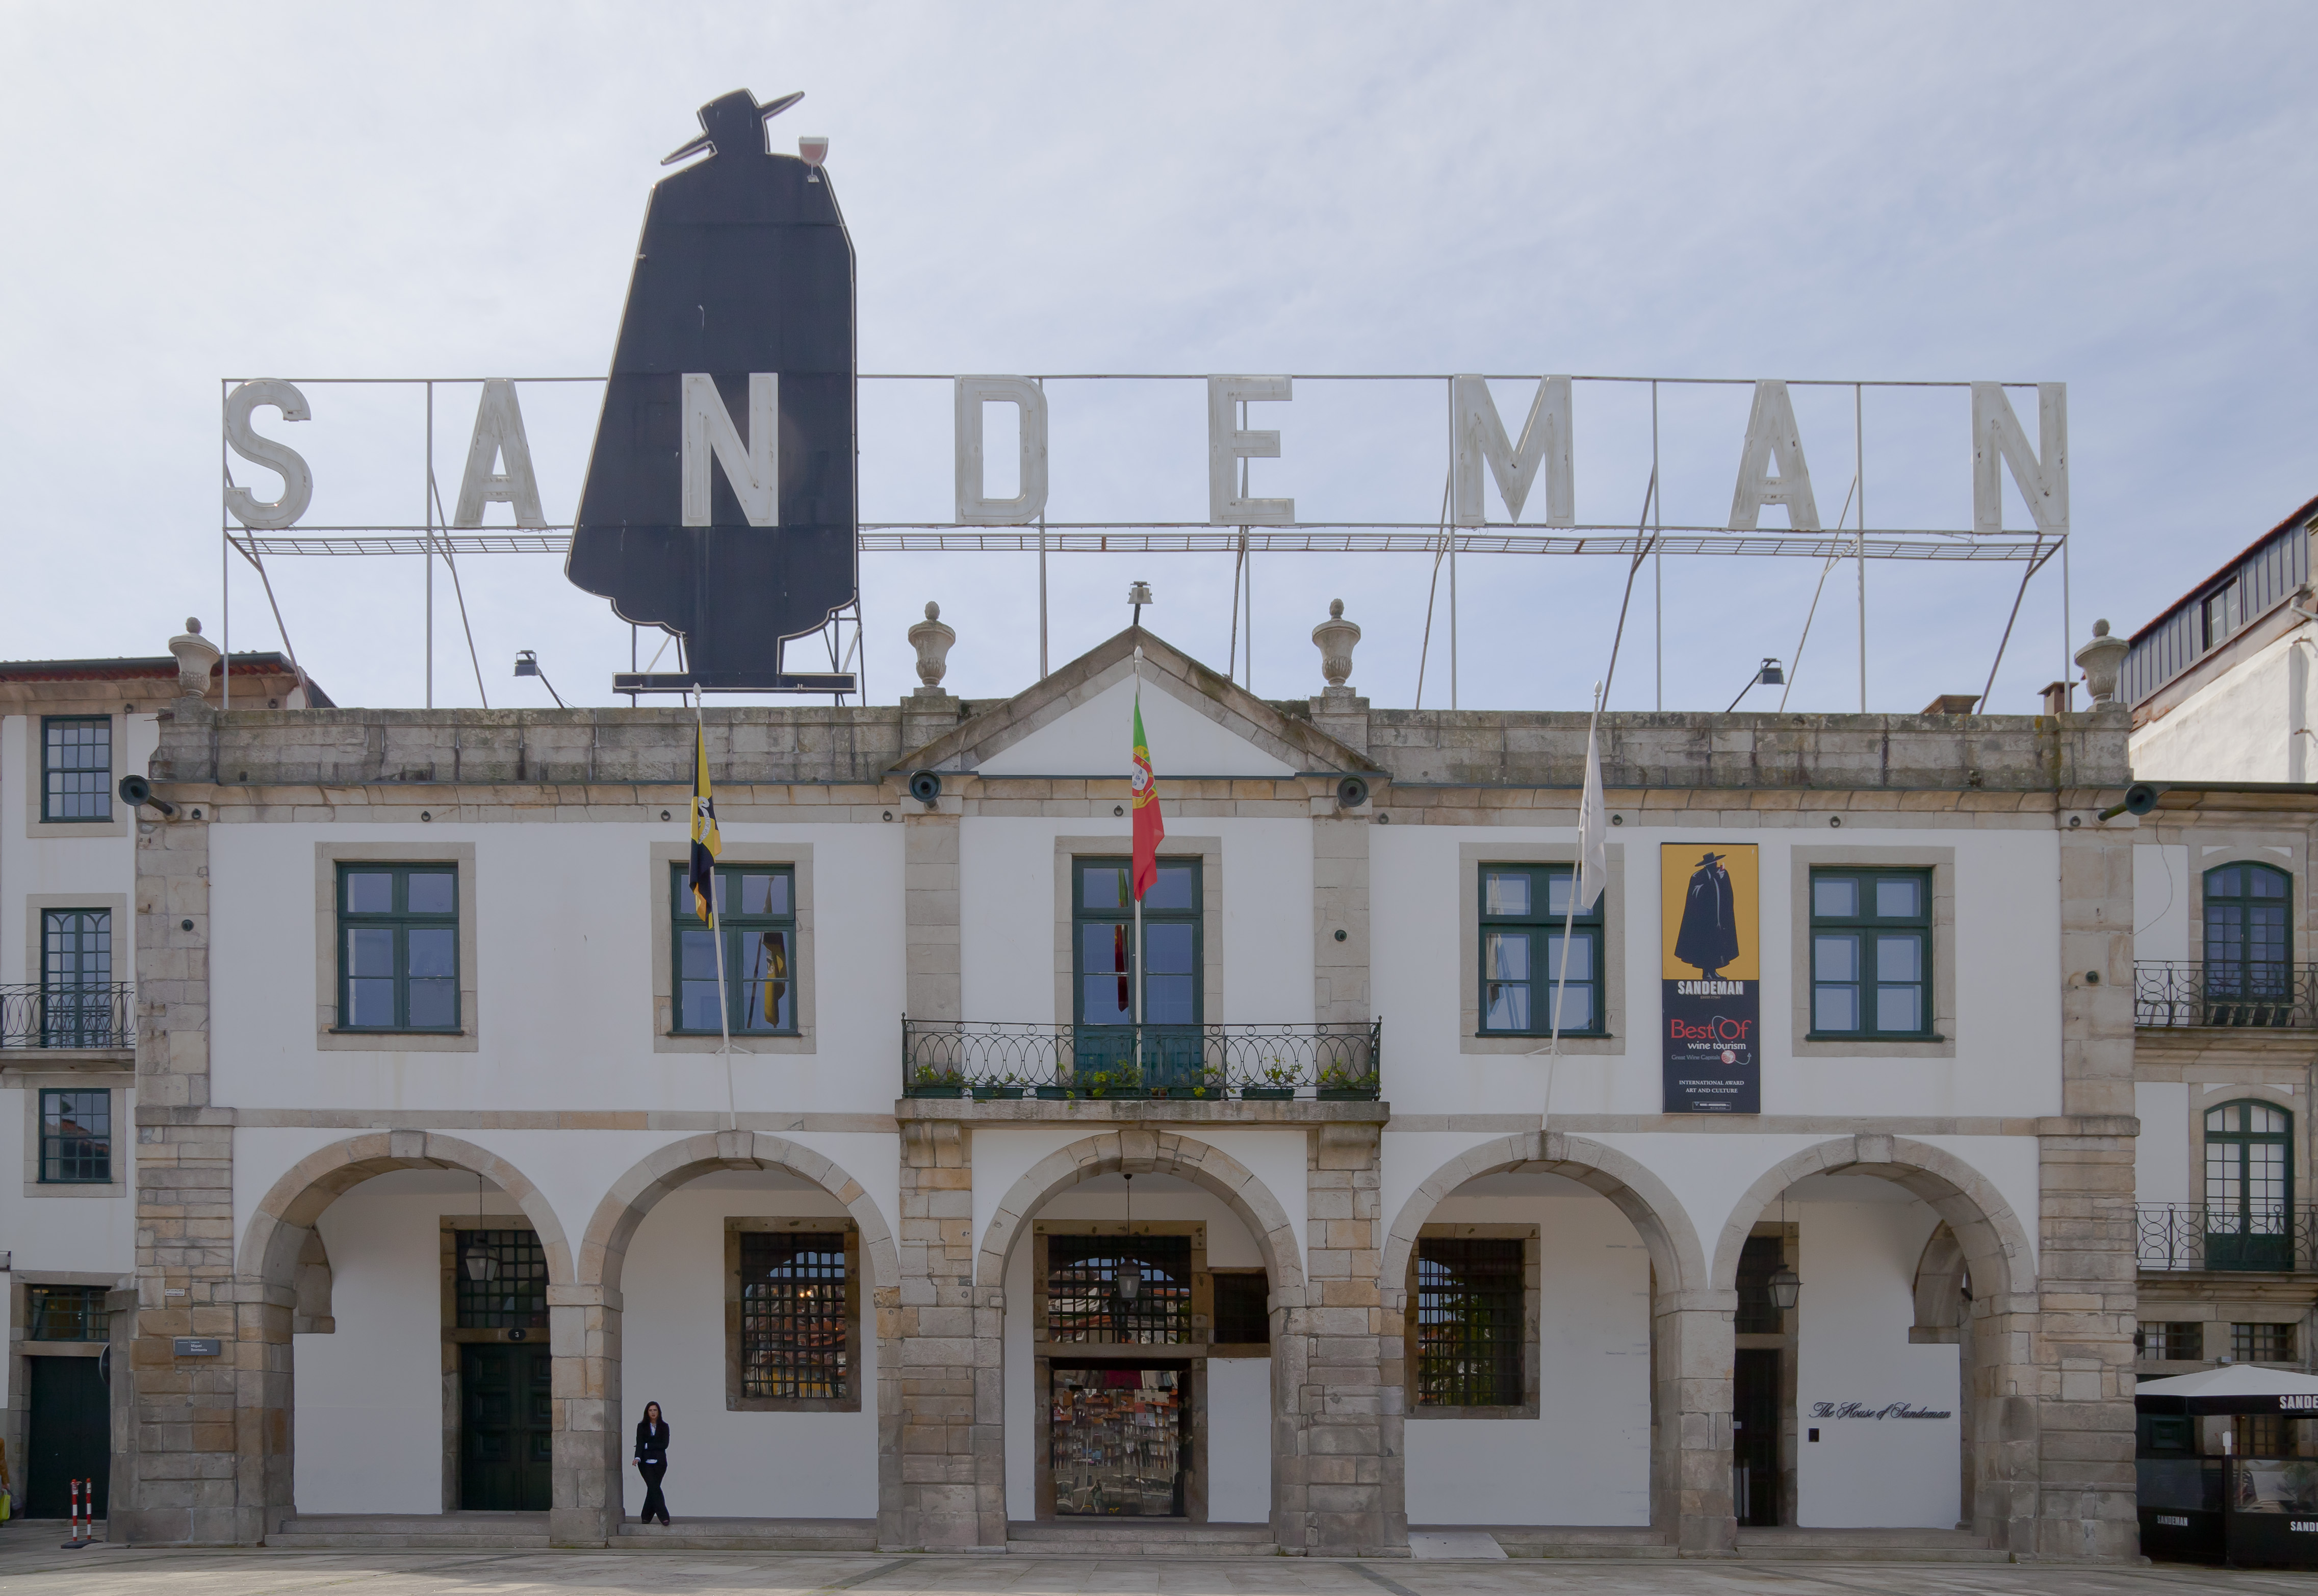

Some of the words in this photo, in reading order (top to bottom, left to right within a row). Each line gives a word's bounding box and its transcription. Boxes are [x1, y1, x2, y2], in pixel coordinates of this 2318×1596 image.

[223, 372, 2069, 535] SANDEMAN
[1678, 981, 1744, 995] SANDEMAN
[1671, 1019, 1715, 1039] Best
[1719, 1019, 1752, 1040] Of
[1687, 1041, 1711, 1050] wine
[1713, 1041, 1746, 1050] tourism
[1809, 1402, 1835, 1418] The
[1836, 1402, 1876, 1420] House
[1876, 1404, 1894, 1421] of
[1890, 1402, 1951, 1420] Sandeman
[2157, 1515, 2188, 1526] SANDEMAN
